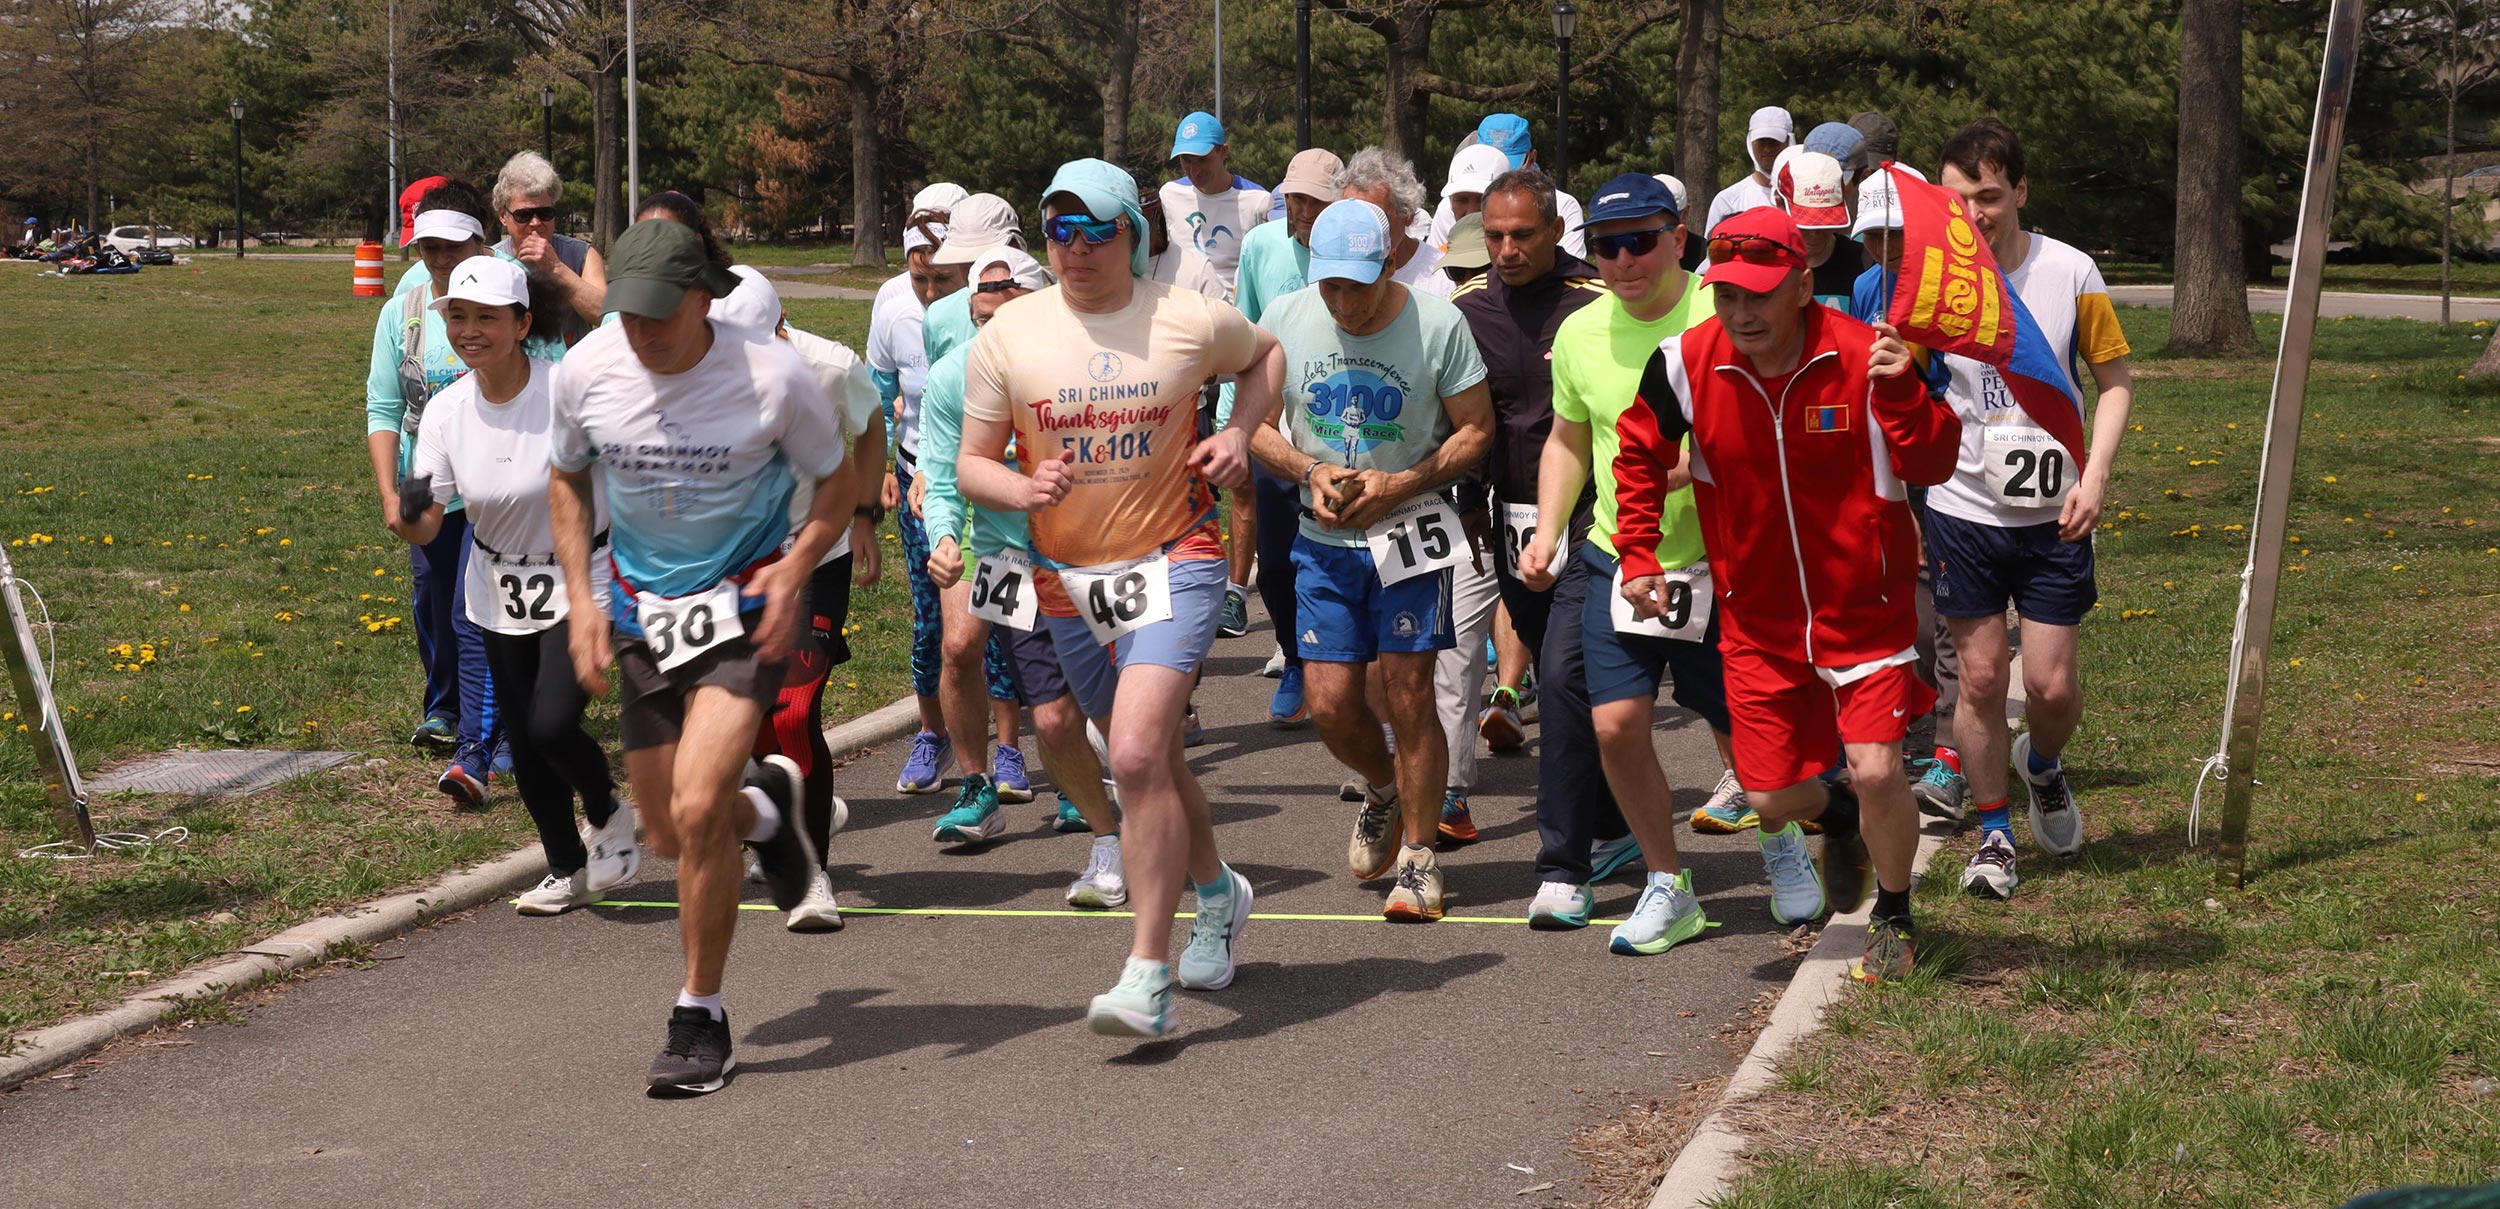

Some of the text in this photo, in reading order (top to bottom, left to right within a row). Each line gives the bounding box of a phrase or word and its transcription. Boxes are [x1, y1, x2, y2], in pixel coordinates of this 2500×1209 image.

[1348, 236, 1368, 247] 3100
[1058, 381, 1159, 404] SRI CHINMOY
[1307, 382, 1403, 421] 3100
[1983, 390, 2017, 410] RU
[1027, 398, 1172, 434] Thanksgiving
[1314, 425, 1396, 438] Mile Race
[1993, 433, 2009, 442] SRI
[2004, 449, 2063, 498] 20
[1385, 502, 1422, 519] CHINMOY
[1387, 512, 1451, 568] 15
[500, 573, 556, 620] 32
[972, 562, 1022, 617] 54
[1088, 571, 1148, 629] 48
